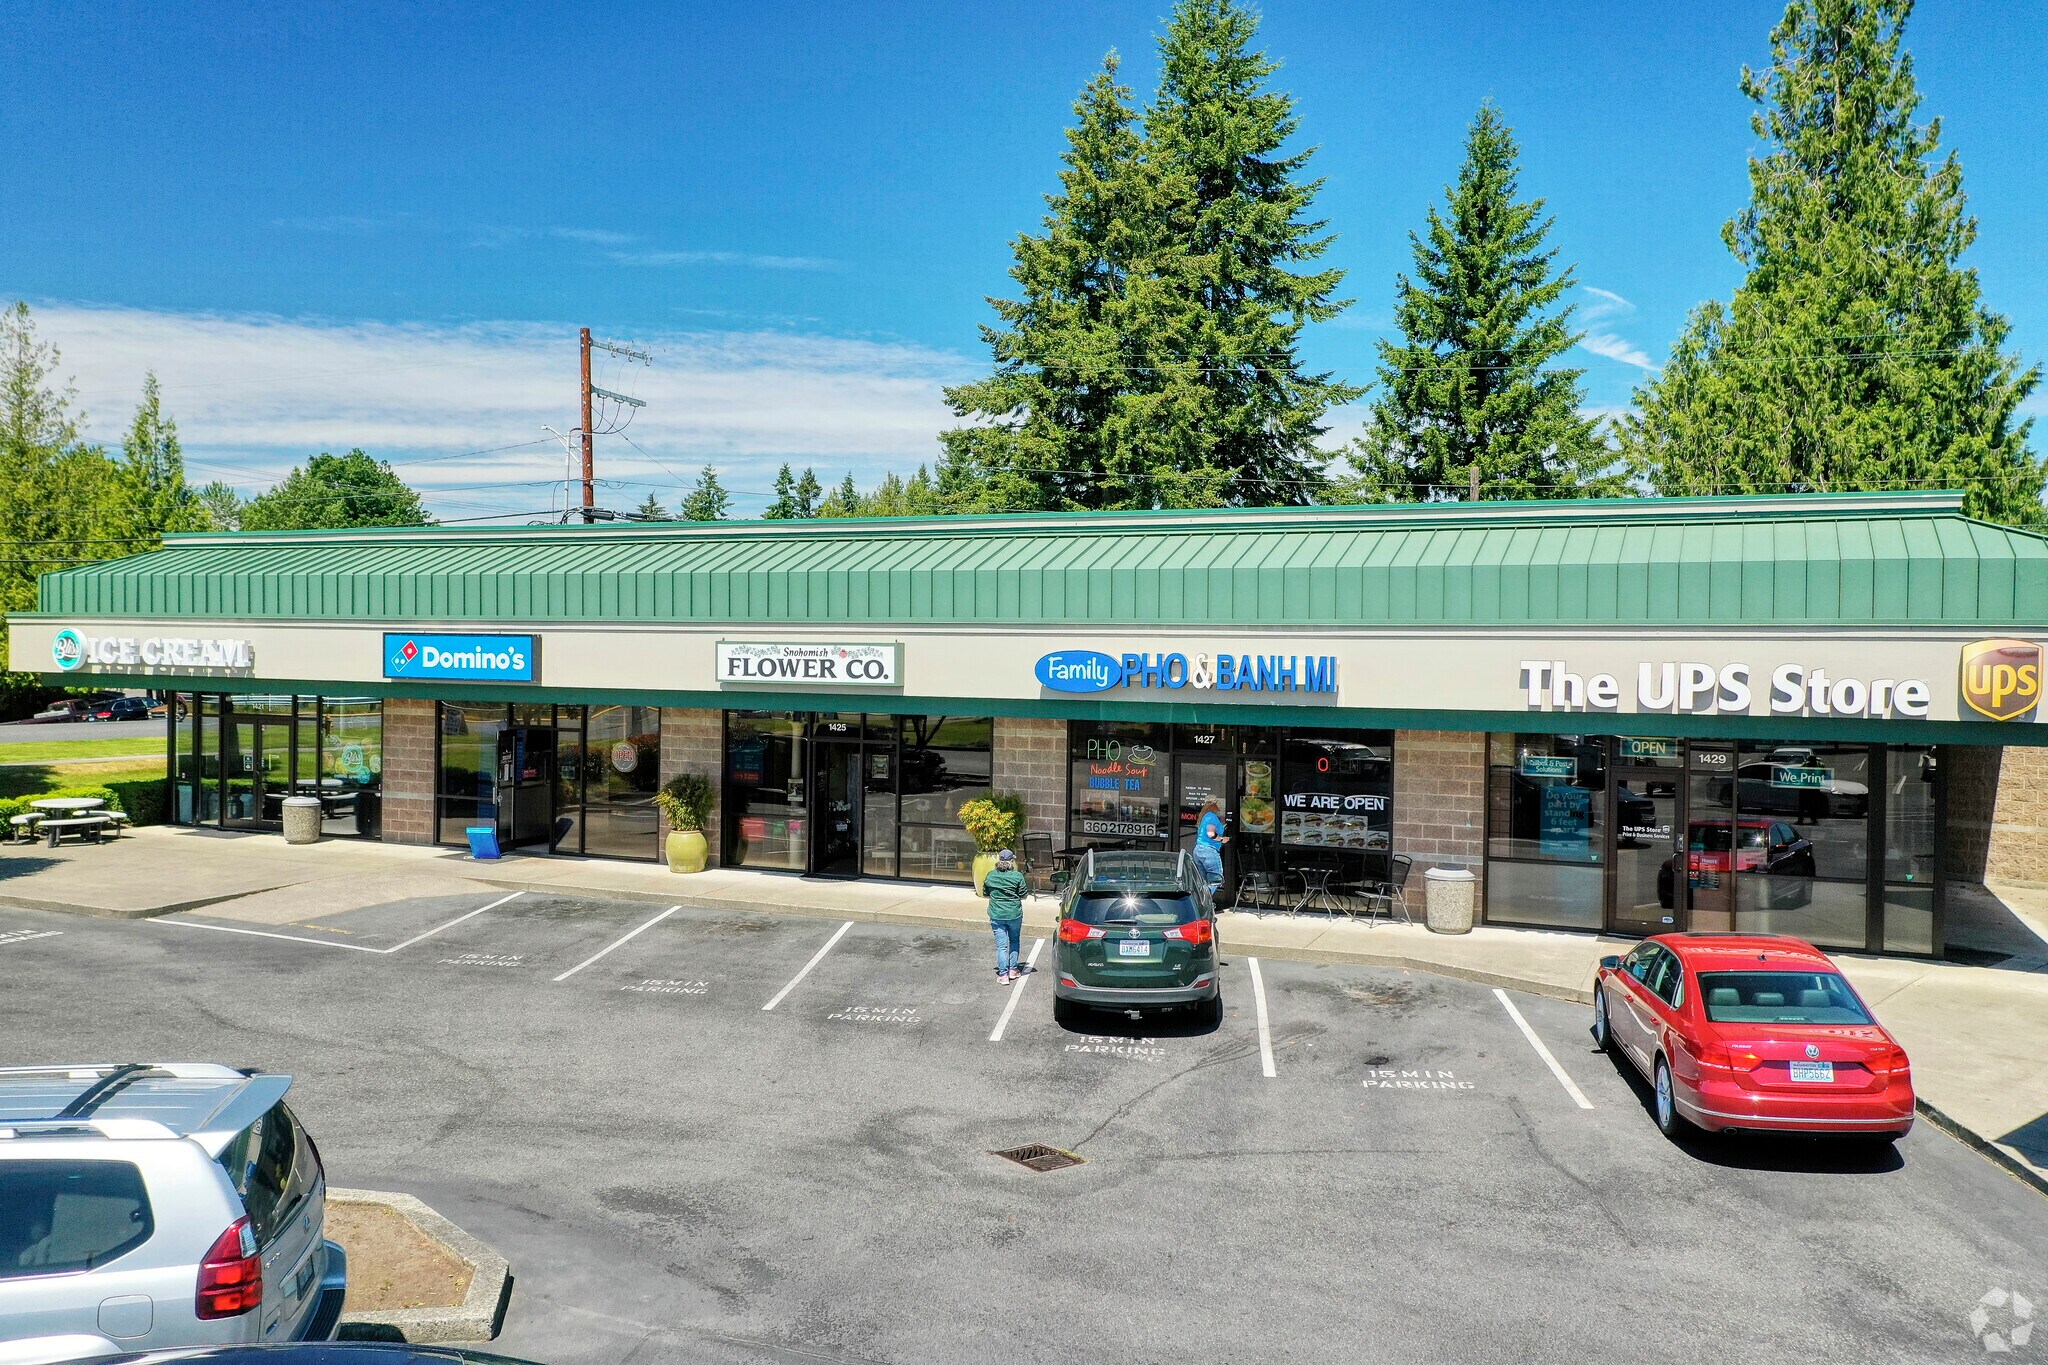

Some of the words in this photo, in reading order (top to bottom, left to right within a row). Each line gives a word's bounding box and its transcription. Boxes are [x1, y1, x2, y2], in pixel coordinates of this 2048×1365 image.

[56, 639, 79, 659] Bliss
[88, 637, 135, 664] ICE
[142, 638, 247, 667] CREAM
[783, 647, 828, 658] Snohomish
[422, 645, 525, 670] Domino's
[727, 658, 837, 679] FLOWER
[846, 659, 889, 680] CO.
[1048, 657, 1109, 687] Family
[1121, 653, 1189, 689] PHO
[1192, 653, 1212, 690] &
[1216, 654, 1297, 692] BANH
[1304, 656, 1336, 692] MI
[1520, 660, 1619, 708] The
[1637, 662, 1751, 712] UPS
[1771, 663, 1930, 716] Store
[1969, 664, 2037, 707] ups
[828, 723, 847, 732] 1425
[1194, 735, 1215, 744] 1427
[1087, 739, 1121, 761] PHO
[1631, 741, 1666, 754] OPEN
[1698, 754, 1727, 764] 1429
[1090, 762, 1122, 775] Noodle
[1125, 763, 1148, 777] Soup
[1089, 777, 1120, 789] BUBBLE
[1124, 779, 1141, 790] TEA
[1779, 771, 1796, 783] We
[1800, 773, 1825, 784] Print
[1284, 794, 1307, 808] WE
[1311, 795, 1340, 809] ARE
[1344, 797, 1385, 811] OPEN
[437, 959, 521, 967] PARKING
[827, 1014, 920, 1022] PARKING
[1065, 1045, 1165, 1055] PARKING
[1369, 1070, 1396, 1078] 15
[1402, 1070, 1454, 1079] MIN
[1362, 1081, 1475, 1089] PARKING
